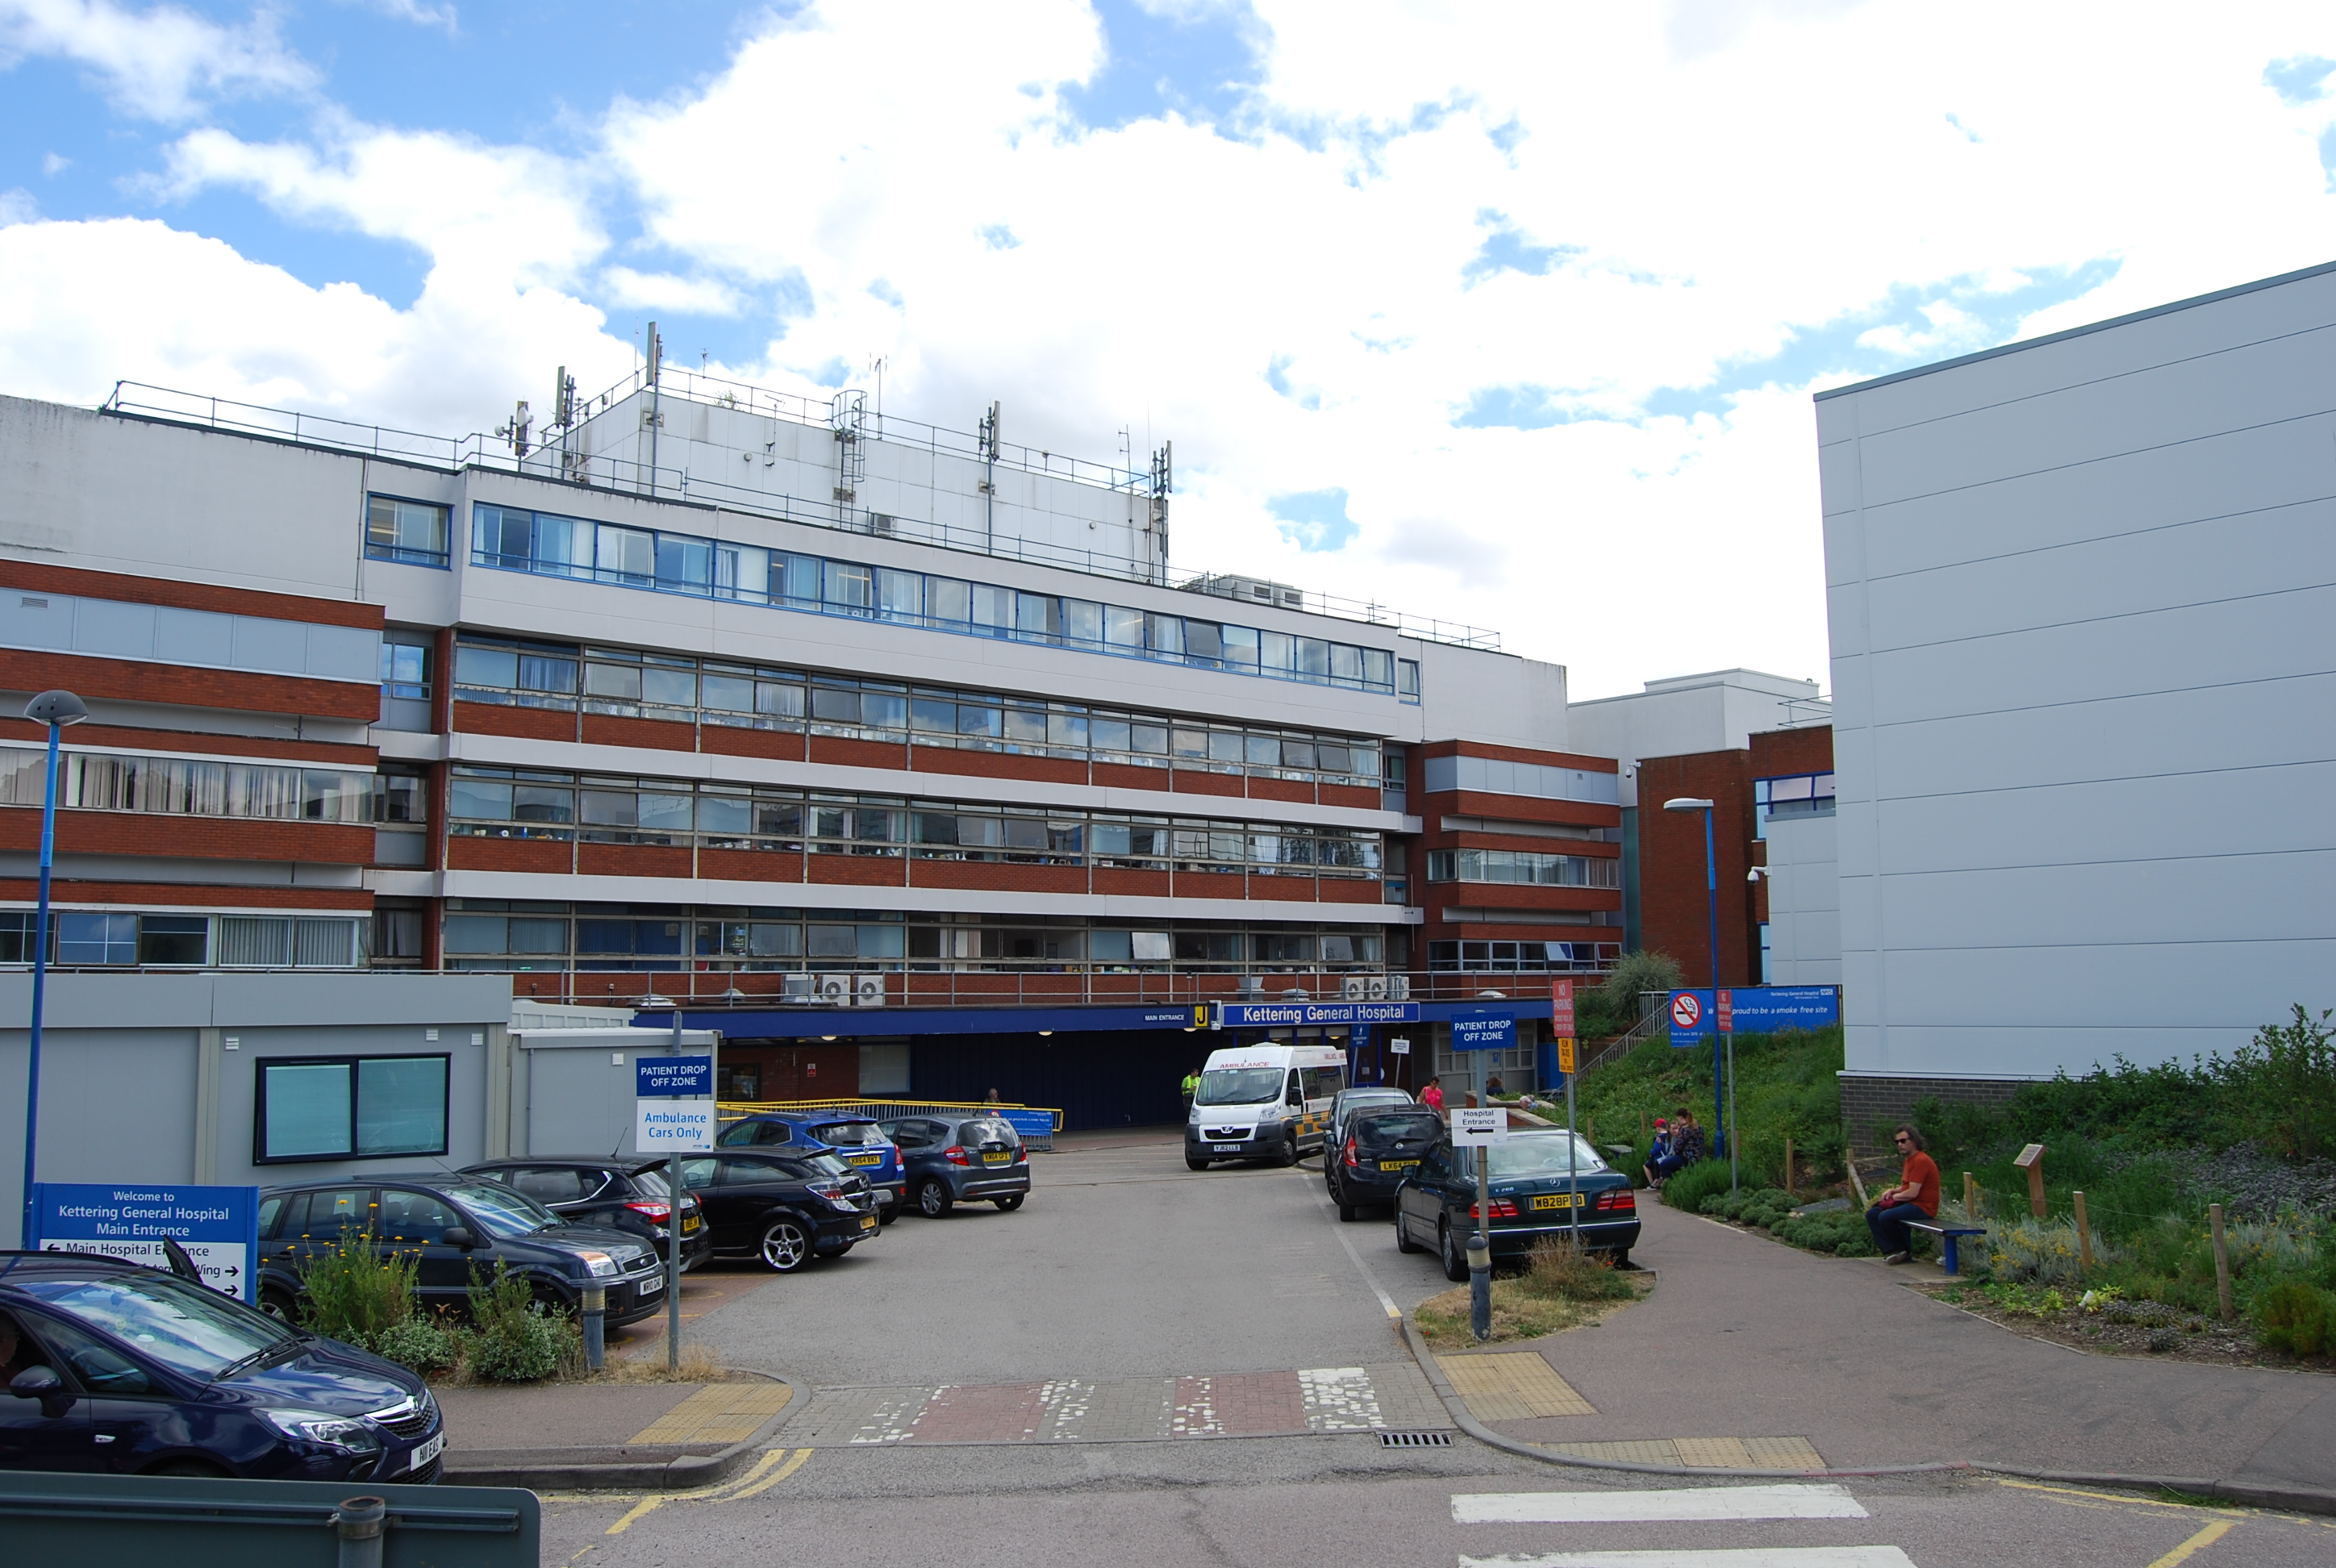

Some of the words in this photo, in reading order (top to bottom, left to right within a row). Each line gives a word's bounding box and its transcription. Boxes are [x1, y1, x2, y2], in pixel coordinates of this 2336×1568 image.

[1558, 984, 1565, 996] NO
[1554, 999, 1571, 1011] PARKING
[1732, 1007, 1751, 1015] proud
[1776, 1006, 1798, 1014] smoke
[1800, 1006, 1814, 1014] free
[1815, 1006, 1828, 1014] site
[1196, 1006, 1206, 1024] J
[1243, 1006, 1302, 1024] Kettering
[1306, 1005, 1353, 1020] General
[1357, 1004, 1404, 1022] Hospital
[1454, 1021, 1487, 1032] PATIENT
[1488, 1020, 1512, 1030] DROP
[1463, 1032, 1479, 1041] OFF
[1481, 1031, 1504, 1040] ZONE
[640, 1066, 678, 1076] PATIENT
[680, 1065, 707, 1075] DROP
[1219, 1061, 1269, 1070] AMBULANCE
[651, 1078, 670, 1087] OFF
[671, 1077, 698, 1086] ZONE
[644, 1111, 707, 1124] Ambulance
[1463, 1110, 1494, 1118] Hospital
[649, 1127, 673, 1138] Cars
[676, 1127, 703, 1141] Only
[1383, 1162, 1402, 1170] LK64
[113, 1191, 161, 1202] Welcome
[164, 1192, 175, 1202] to
[59, 1205, 119, 1221] Kettering
[122, 1206, 172, 1219] General
[175, 1207, 229, 1222] Hospital
[96, 1223, 129, 1235] Main
[132, 1224, 190, 1236] Entrance
[66, 1242, 97, 1253] Main
[101, 1243, 151, 1257] Hospital
